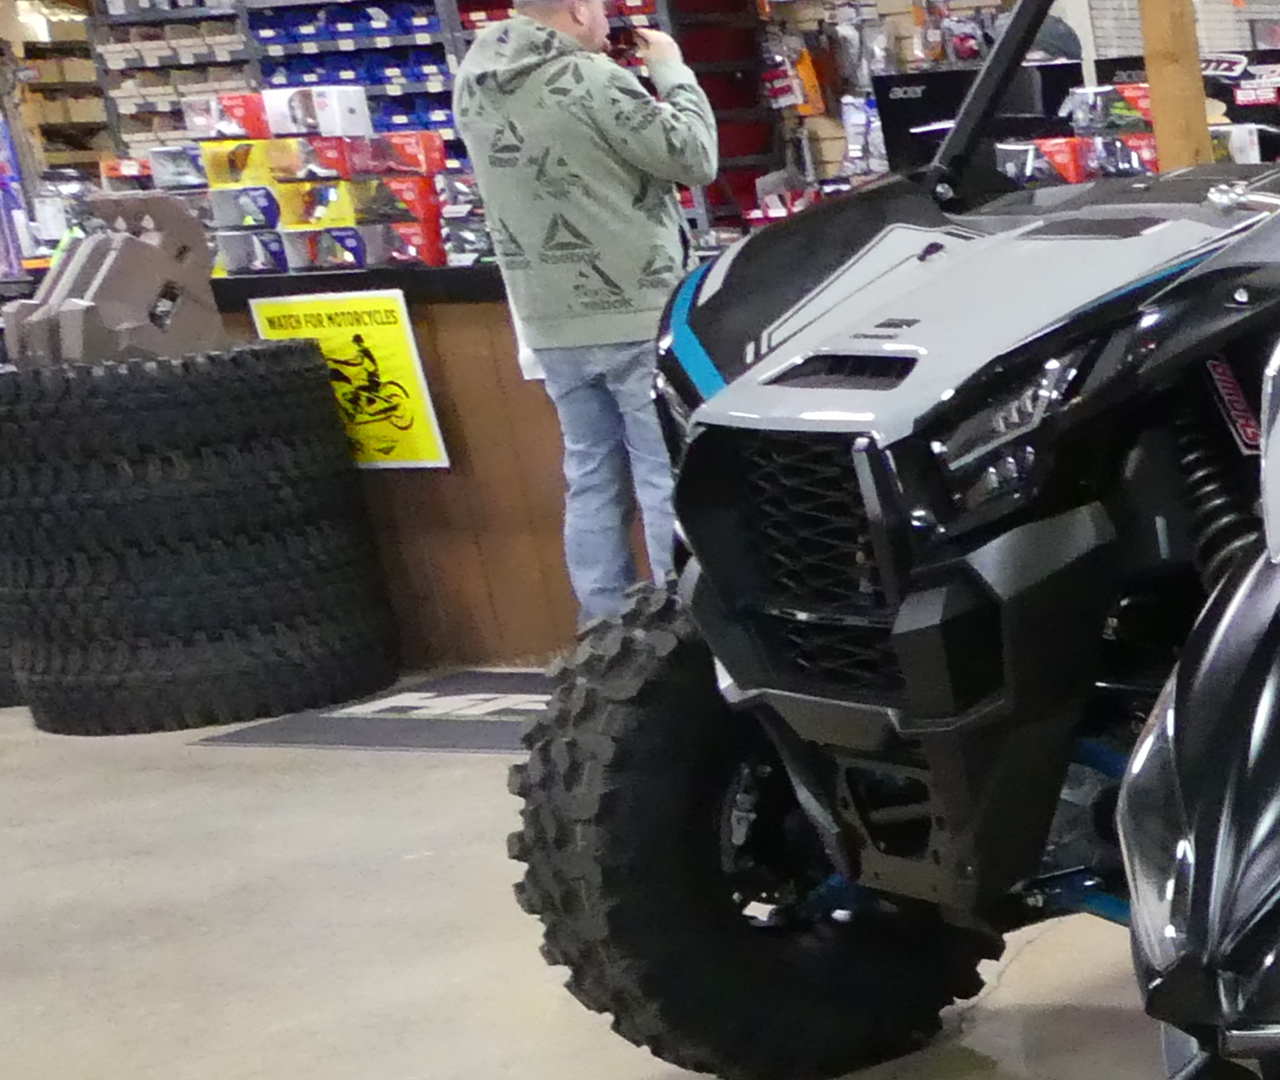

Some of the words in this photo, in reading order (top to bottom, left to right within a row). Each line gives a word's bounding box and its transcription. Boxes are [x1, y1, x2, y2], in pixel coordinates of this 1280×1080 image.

[1113, 70, 1147, 83] ace
[889, 85, 926, 99] acer
[265, 314, 302, 331] WATCH
[304, 312, 326, 329] FOR
[325, 308, 399, 328] MOTORCYCLES
